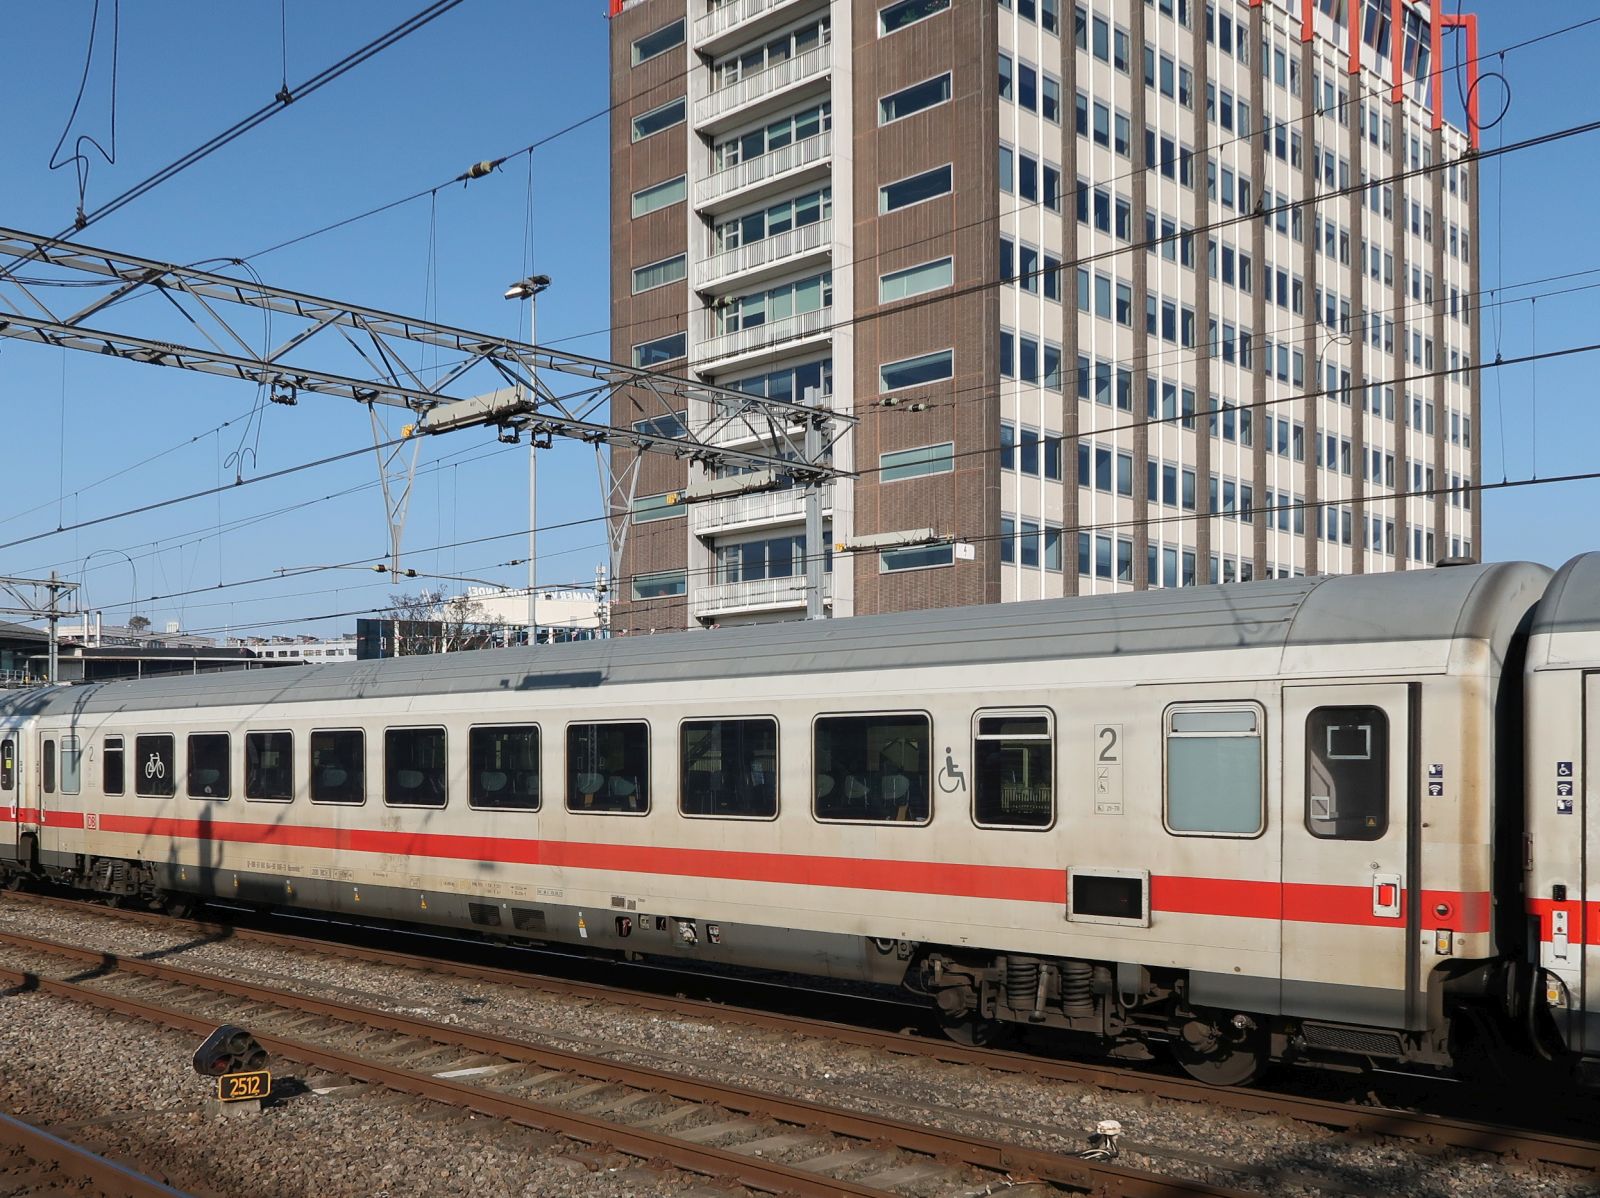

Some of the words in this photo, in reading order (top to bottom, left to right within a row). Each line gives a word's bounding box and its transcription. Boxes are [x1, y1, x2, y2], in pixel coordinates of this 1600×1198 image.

[88, 745, 94, 762] 2
[1098, 727, 1117, 762] 2
[229, 1076, 260, 1096] 2512
